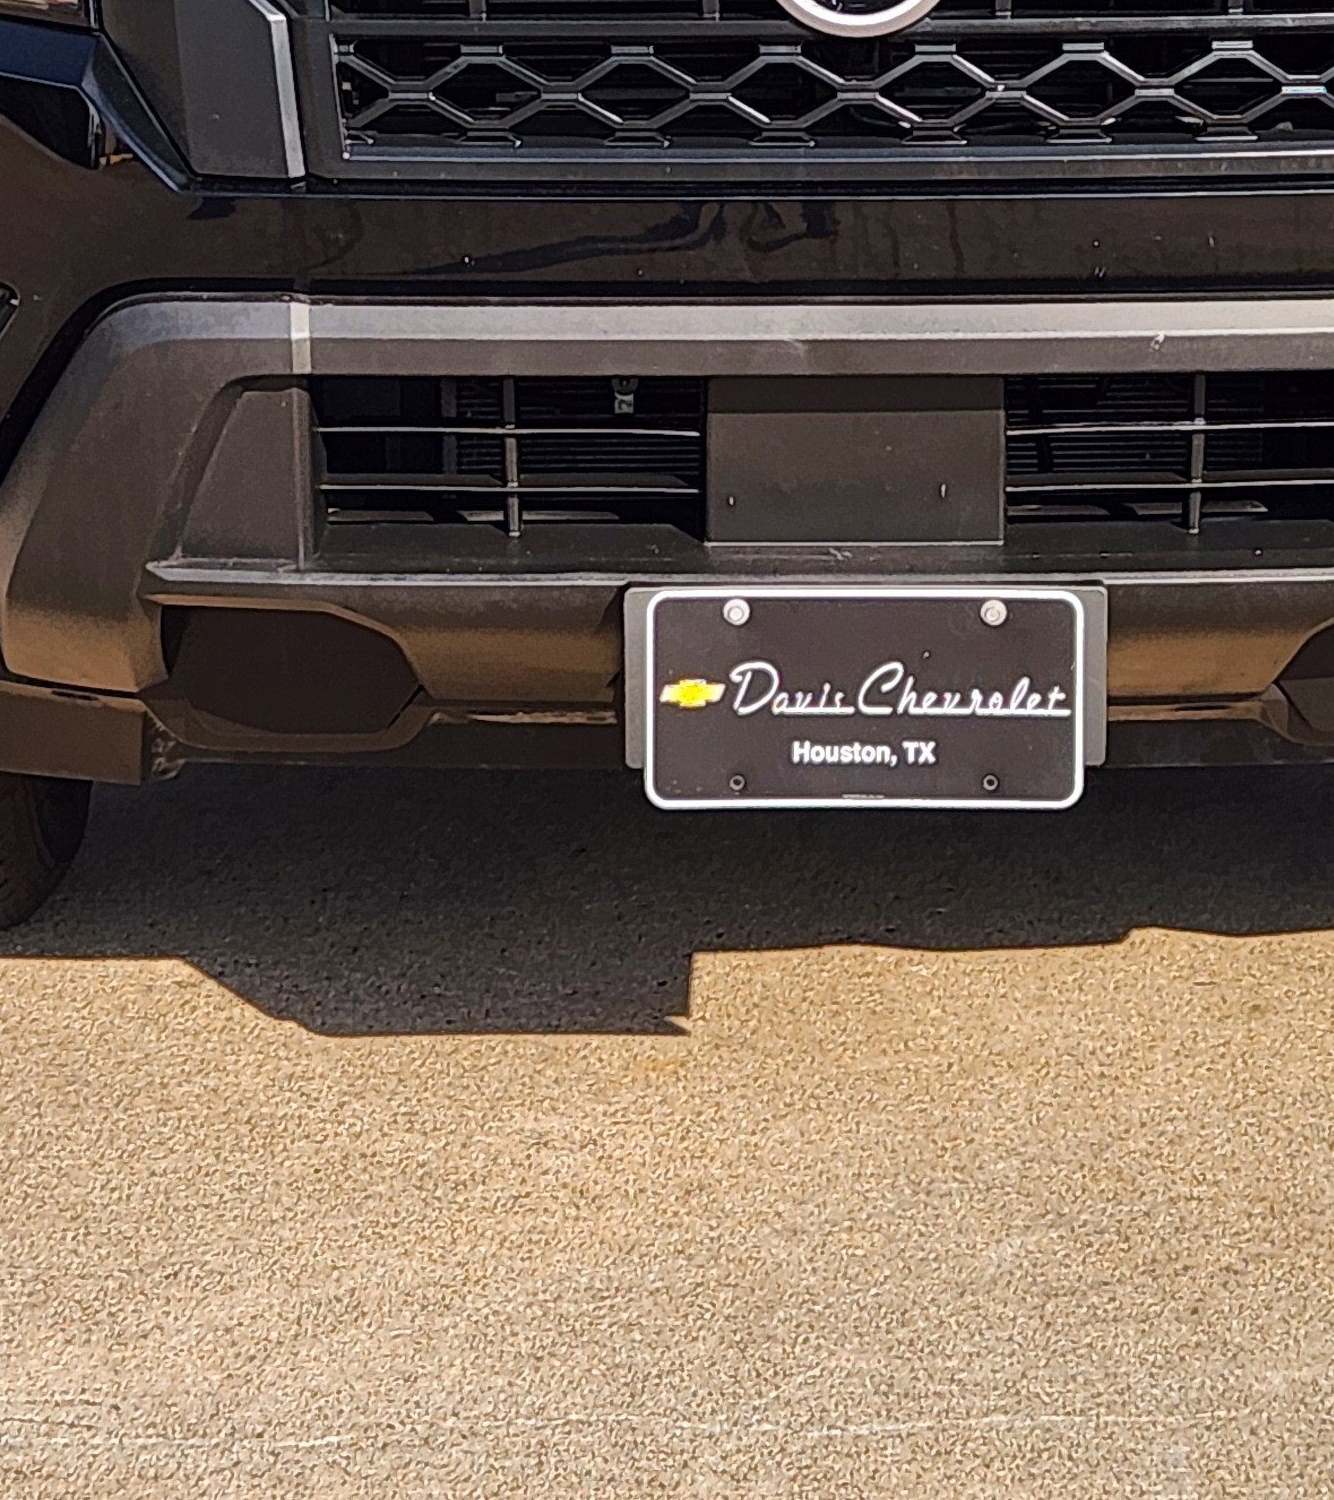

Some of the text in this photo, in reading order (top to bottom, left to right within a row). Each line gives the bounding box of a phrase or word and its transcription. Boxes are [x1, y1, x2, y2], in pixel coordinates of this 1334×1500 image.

[729, 661, 1072, 717] Davis Chevrolet
[791, 739, 938, 767] Houston, TX
